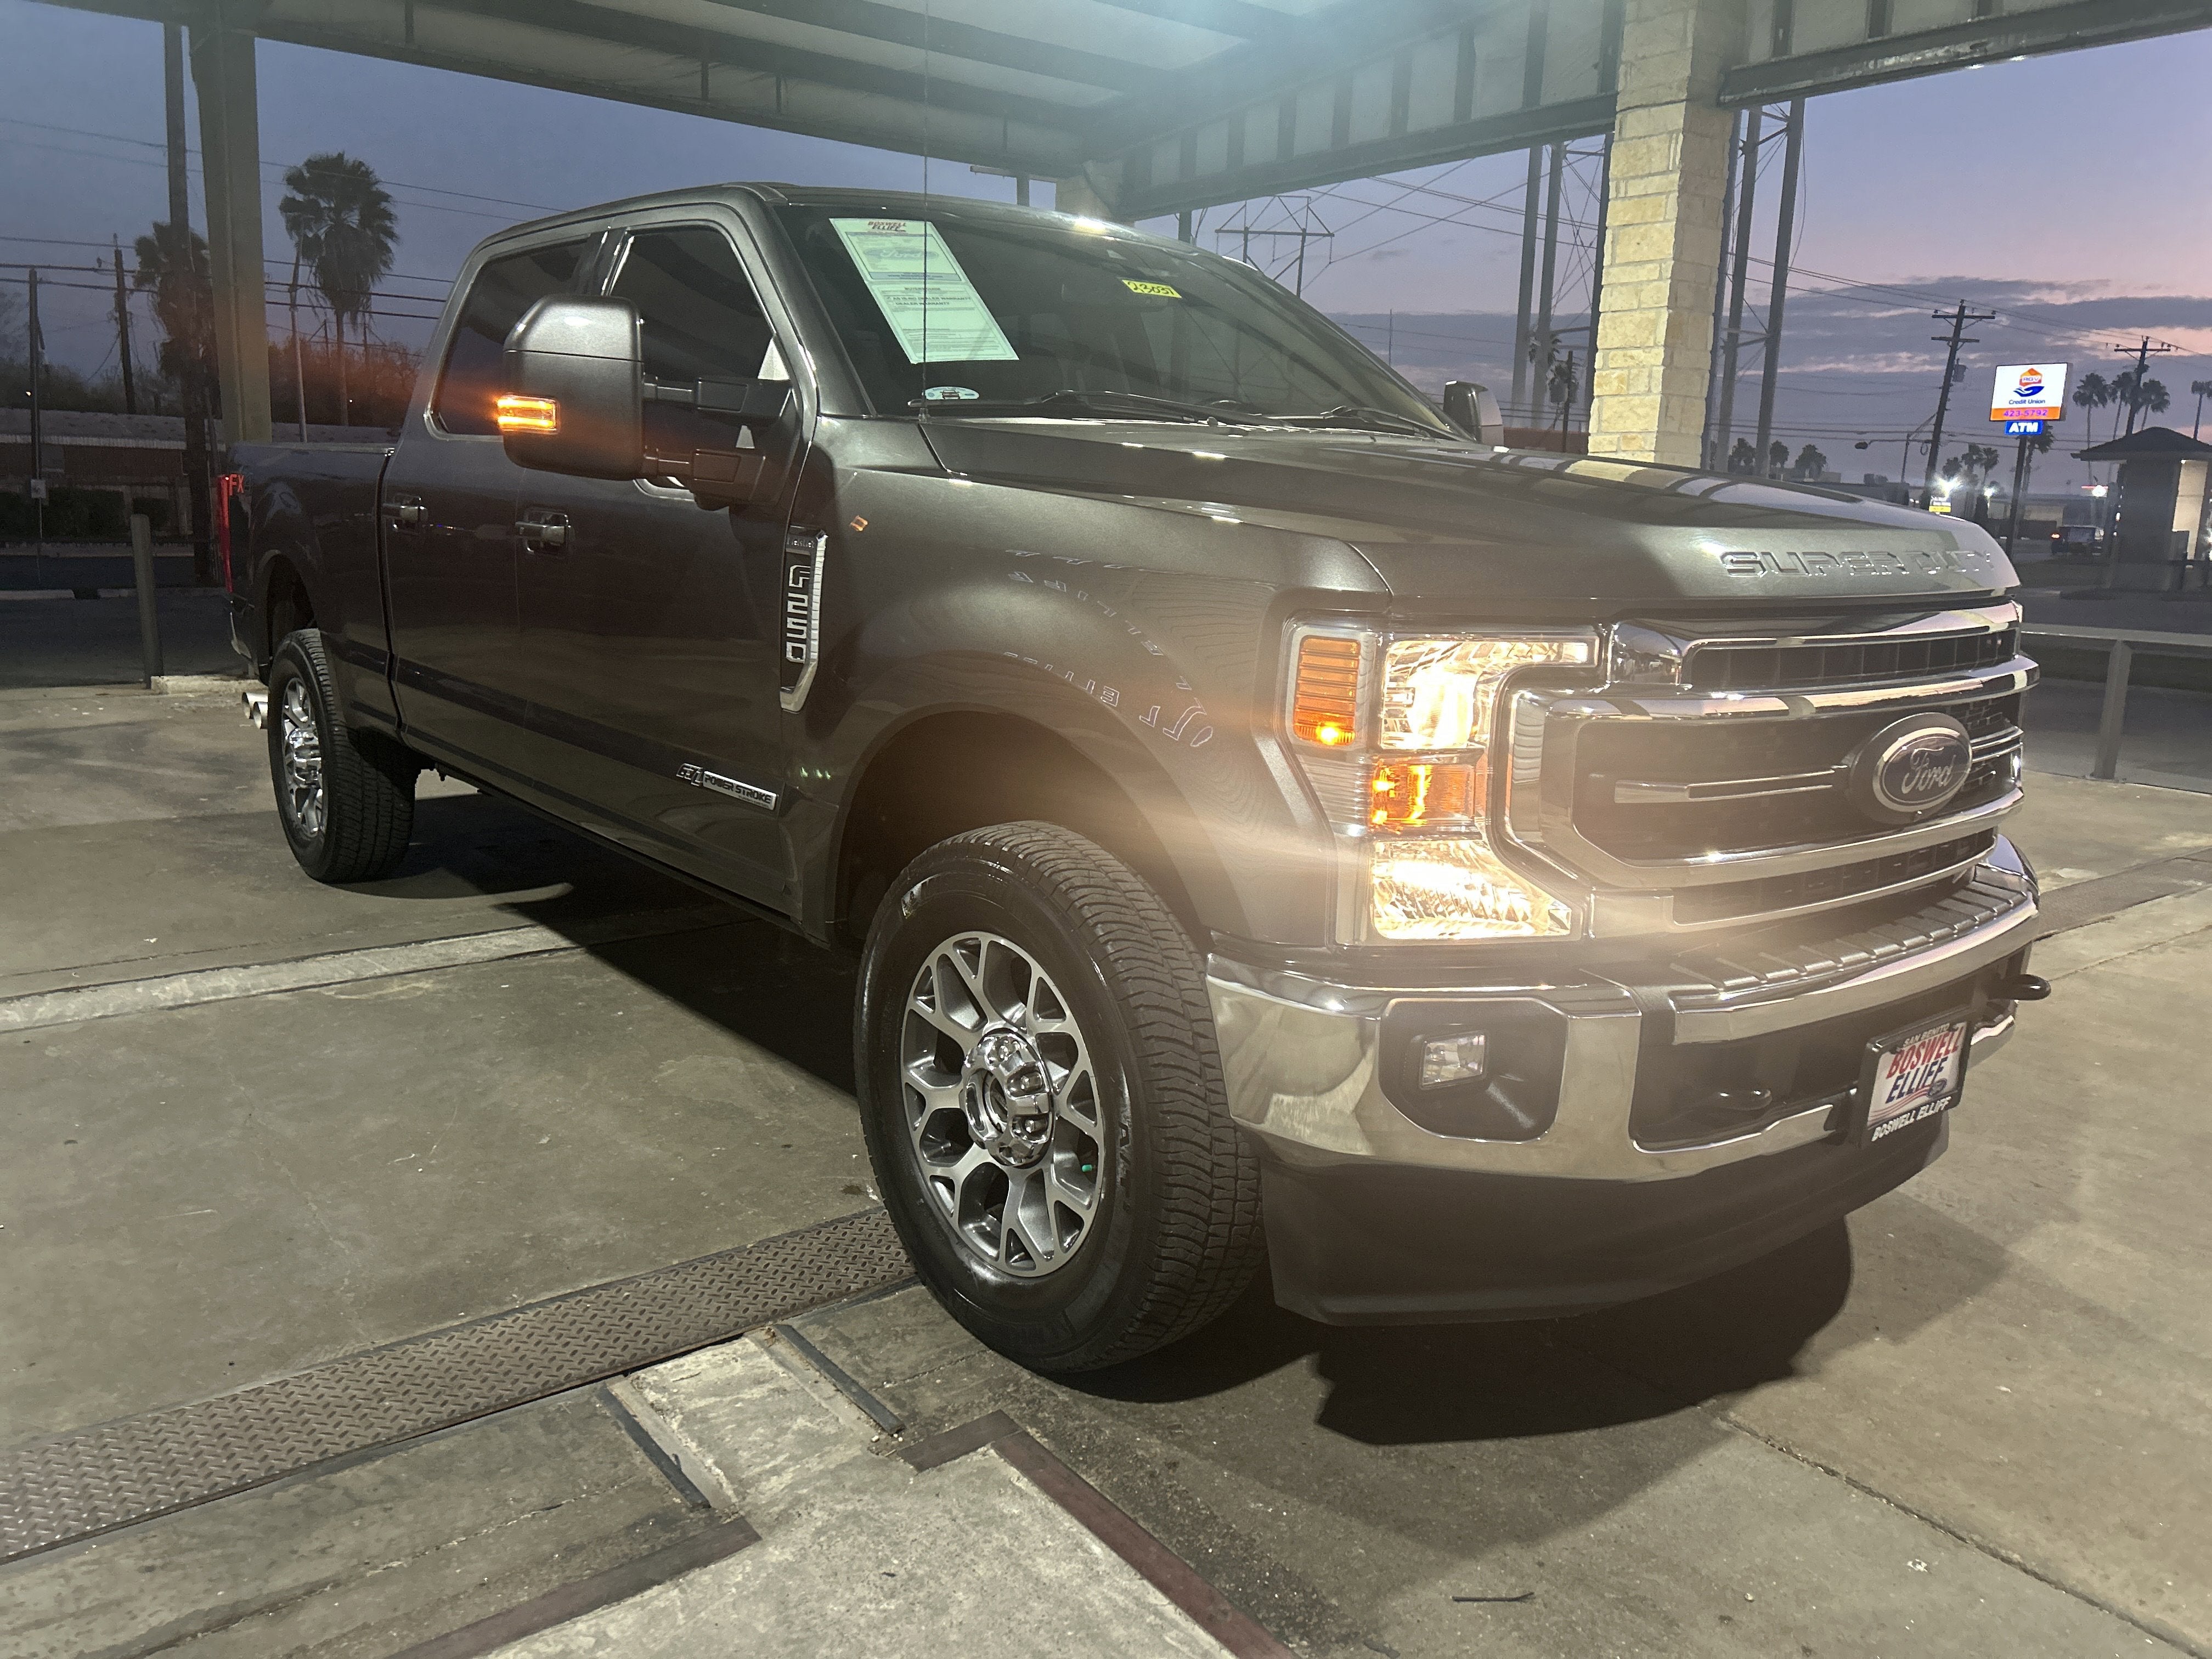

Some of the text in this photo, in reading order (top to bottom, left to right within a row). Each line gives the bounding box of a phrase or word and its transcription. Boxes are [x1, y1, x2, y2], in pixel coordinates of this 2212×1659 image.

[2008, 422, 2039, 433] ATM
[1720, 550, 1909, 578] SUPER
[704, 774, 734, 792] POWER
[735, 785, 773, 804] STROKE
[1901, 747, 1957, 794] Ford
[1886, 1025, 1965, 1079] BOSWELL
[1904, 1023, 1951, 1047] SAN BENITO
[1885, 1056, 1949, 1104] ELLIFF
[1871, 1096, 1953, 1142] BOSWELL ELLIFF
